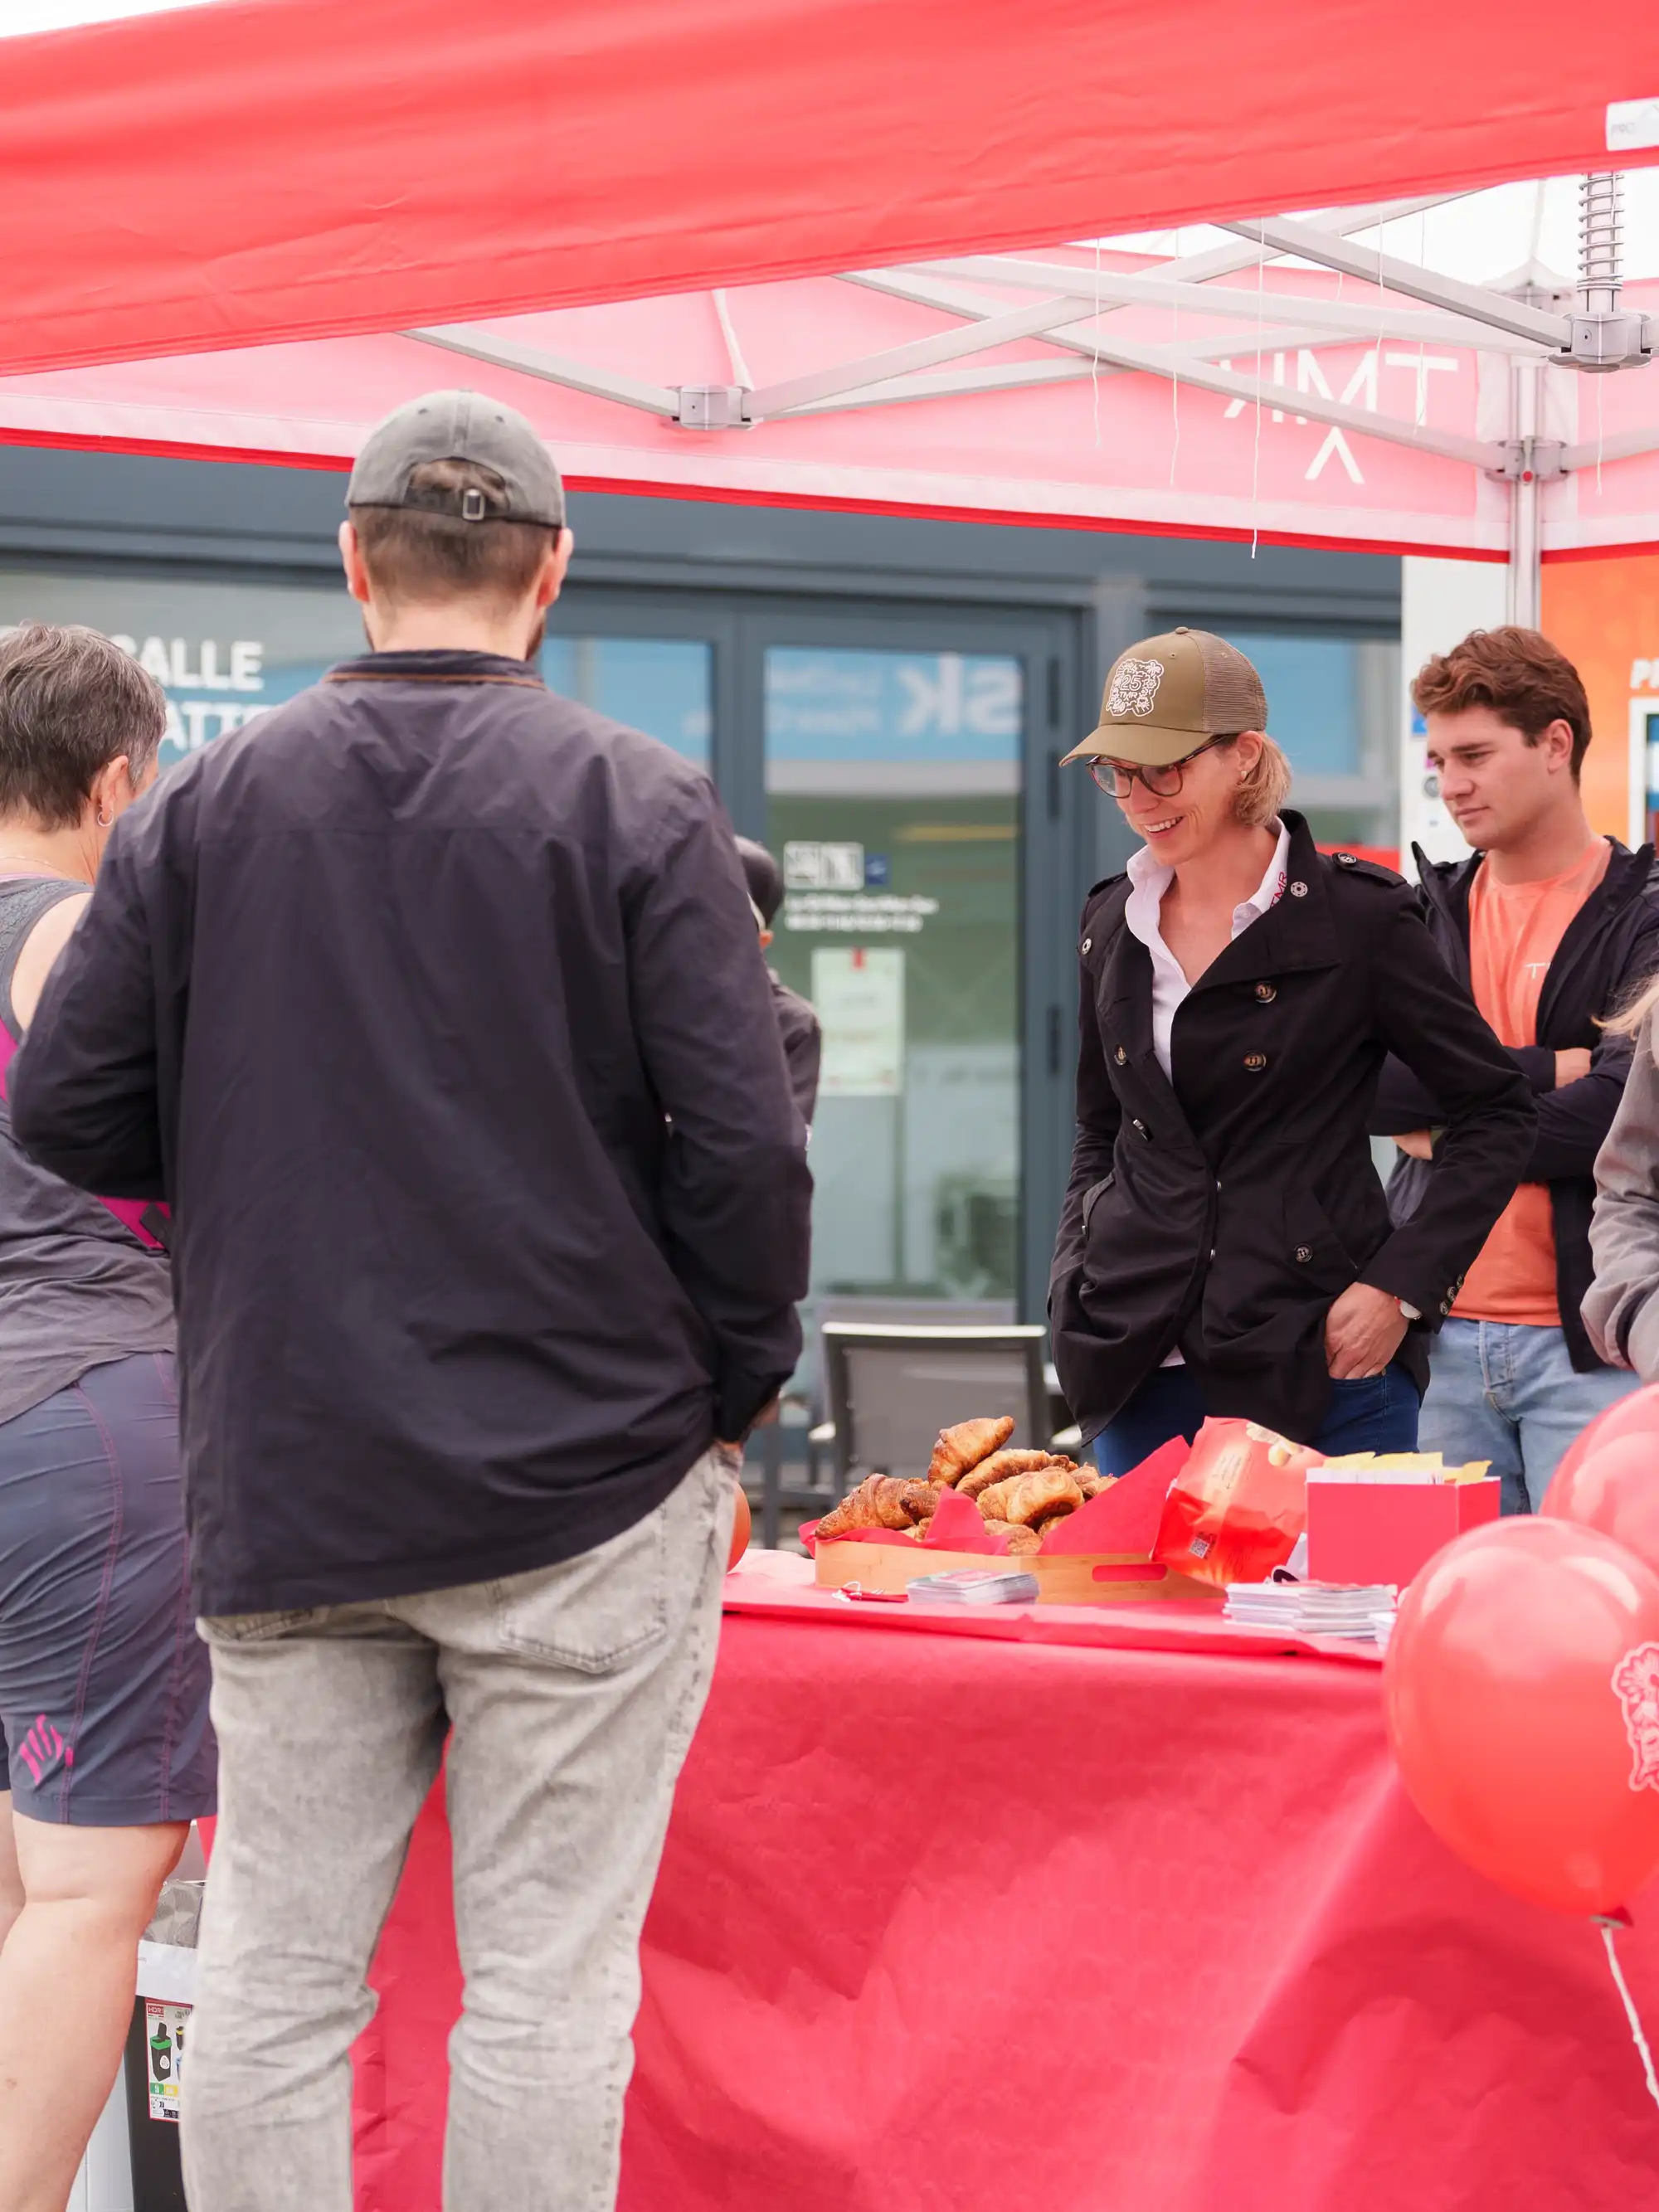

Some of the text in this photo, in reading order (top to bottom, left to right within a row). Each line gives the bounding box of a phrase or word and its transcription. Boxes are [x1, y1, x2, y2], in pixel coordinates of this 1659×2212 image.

[1120, 673, 1141, 692] 25
[1120, 691, 1138, 702] TMR
[1525, 961, 1552, 980] T
